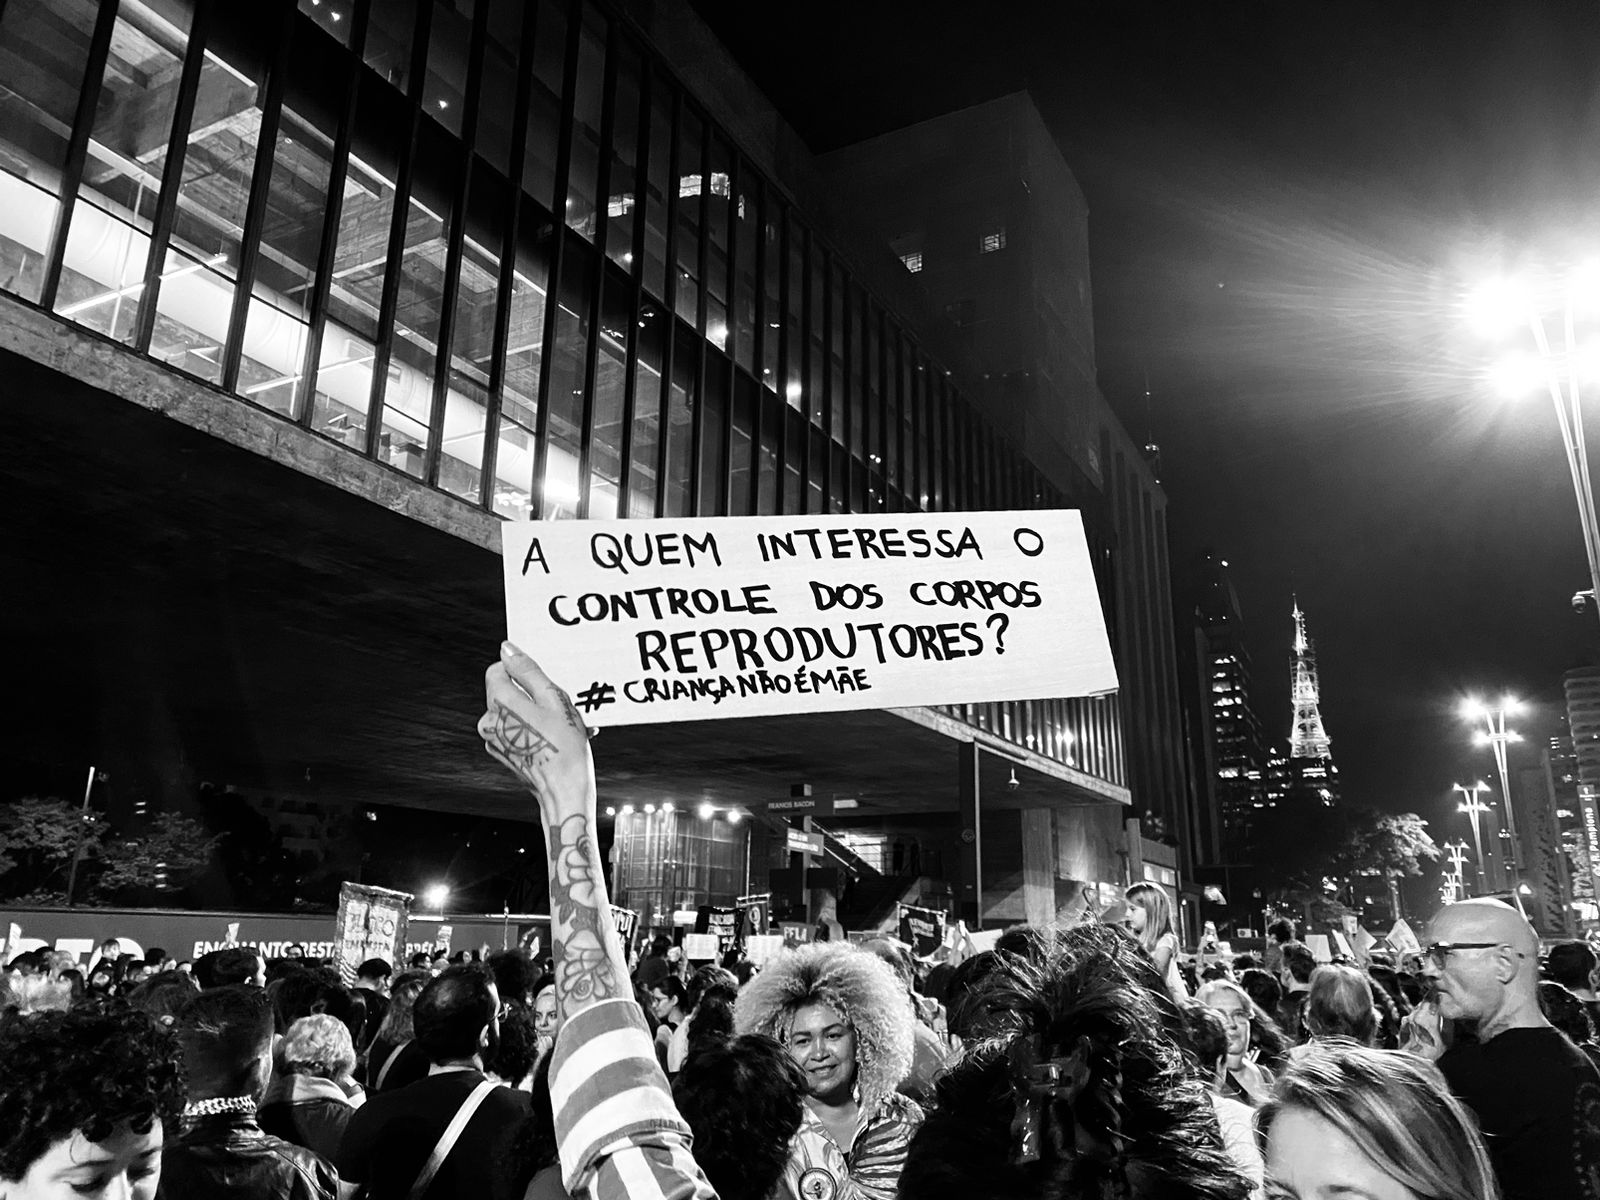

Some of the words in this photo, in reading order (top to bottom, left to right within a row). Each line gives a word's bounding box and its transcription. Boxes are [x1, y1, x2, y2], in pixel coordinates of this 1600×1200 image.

[522, 537, 550, 577] A
[590, 531, 722, 575] QUEM
[757, 526, 983, 562] INTERESSA
[1013, 527, 1044, 557] O
[548, 584, 778, 627] CONTROLE
[809, 580, 884, 611] DOS
[910, 580, 1042, 611] CORPOS
[635, 612, 1010, 674] REPRODUTORES?
[1584, 807, 1599, 852] Pamplona
